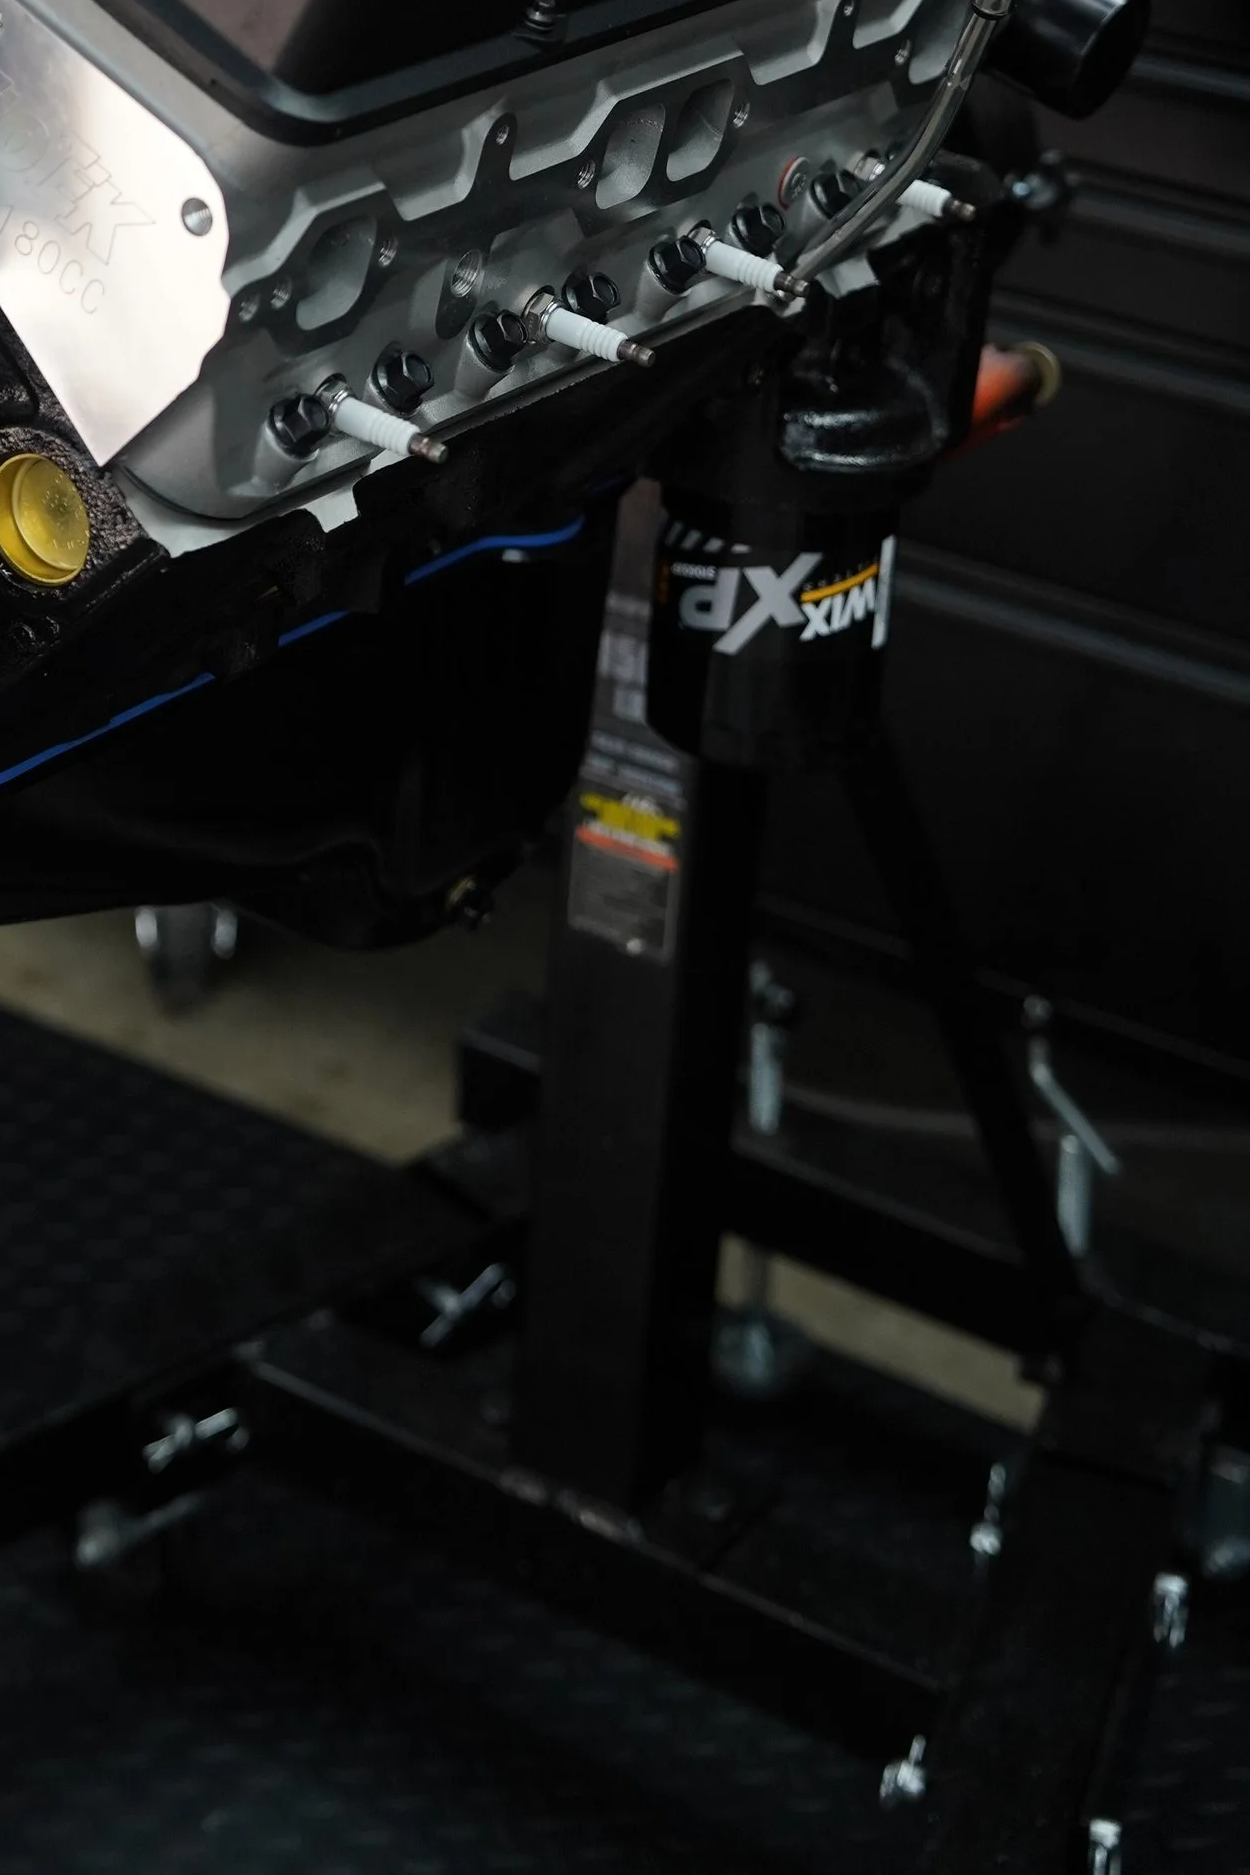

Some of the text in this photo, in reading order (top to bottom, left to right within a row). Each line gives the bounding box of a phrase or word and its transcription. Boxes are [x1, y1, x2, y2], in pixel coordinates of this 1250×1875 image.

[0, 204, 106, 315] 180CC
[678, 551, 824, 657] XP
[800, 577, 877, 642] WIX
